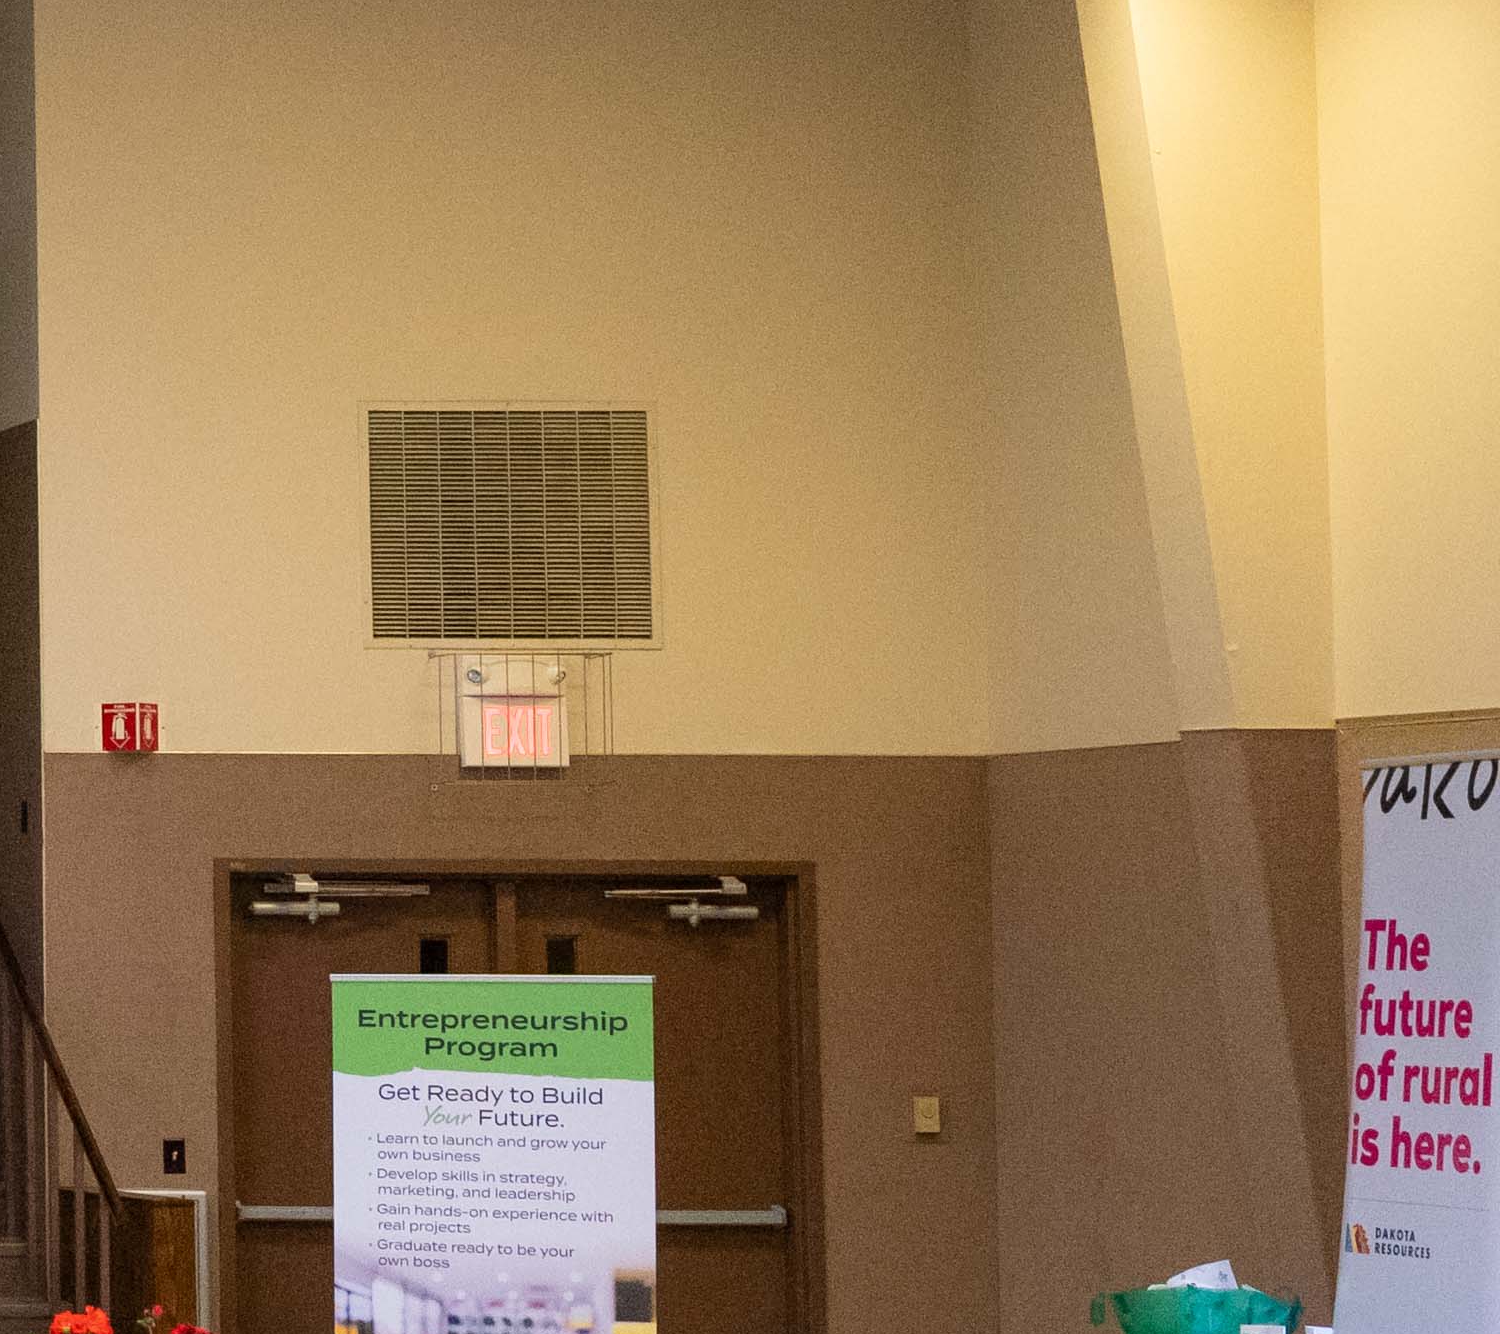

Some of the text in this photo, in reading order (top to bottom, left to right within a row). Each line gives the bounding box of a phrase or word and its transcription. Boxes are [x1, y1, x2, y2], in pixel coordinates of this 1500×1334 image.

[484, 707, 553, 755] EXIT
[1364, 920, 1430, 971] The
[1359, 983, 1473, 1038] future
[358, 1010, 628, 1035] Entrepreneurship
[425, 1037, 558, 1060] Program
[1355, 1049, 1493, 1107] of rural
[378, 1084, 603, 1106] Get Ready to Build
[423, 1105, 565, 1127] Your Future.
[377, 1133, 607, 1151] Learn to launch and grow your
[1350, 1113, 1481, 1174] is here.
[377, 1150, 481, 1162] own business
[377, 1168, 567, 1187] Develop skills in strategy,
[378, 1185, 576, 1203] marketing, and leadership
[377, 1203, 613, 1223] Gain hands-on experience with
[378, 1219, 471, 1234] real projects
[1375, 1227, 1416, 1242] DAKOTA
[377, 1239, 575, 1258] Graduate ready to be your
[1374, 1241, 1431, 1259] RESOURCES
[378, 1256, 450, 1268] own boss
